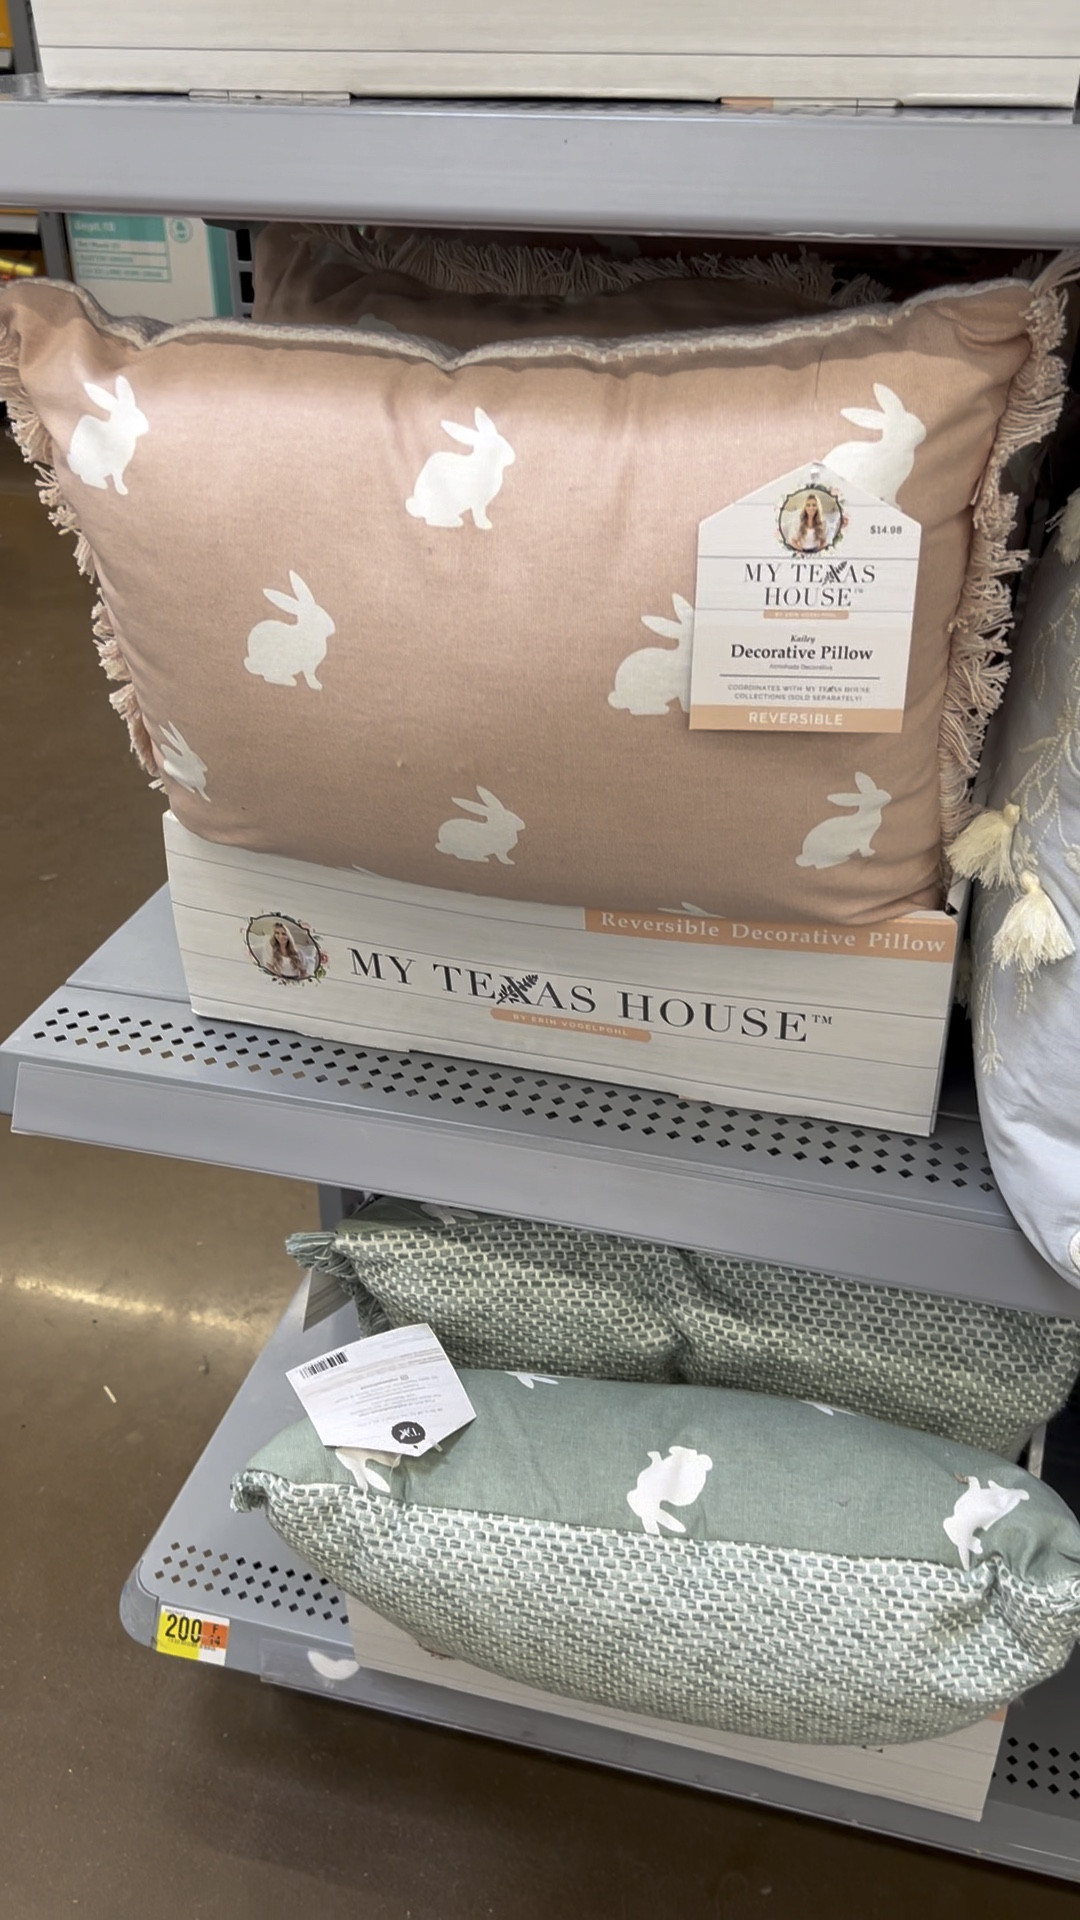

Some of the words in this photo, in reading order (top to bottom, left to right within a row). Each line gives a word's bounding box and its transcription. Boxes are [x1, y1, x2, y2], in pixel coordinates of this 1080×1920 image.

[744, 563, 782, 583] MY
[791, 561, 876, 585] TEXAS
[731, 644, 816, 660] Decorative
[820, 645, 874, 661] Pillow
[728, 684, 781, 692] COORDINATES
[749, 712, 844, 726] REVERSIBLE
[601, 912, 720, 938] Reversible
[732, 923, 856, 948] Decorative
[868, 932, 946, 953] Pillow
[347, 947, 416, 985] MY
[432, 963, 597, 1014] TEXAS
[512, 1013, 527, 1021] BY
[531, 1016, 558, 1025] ERIN
[165, 1613, 203, 1644] 200
